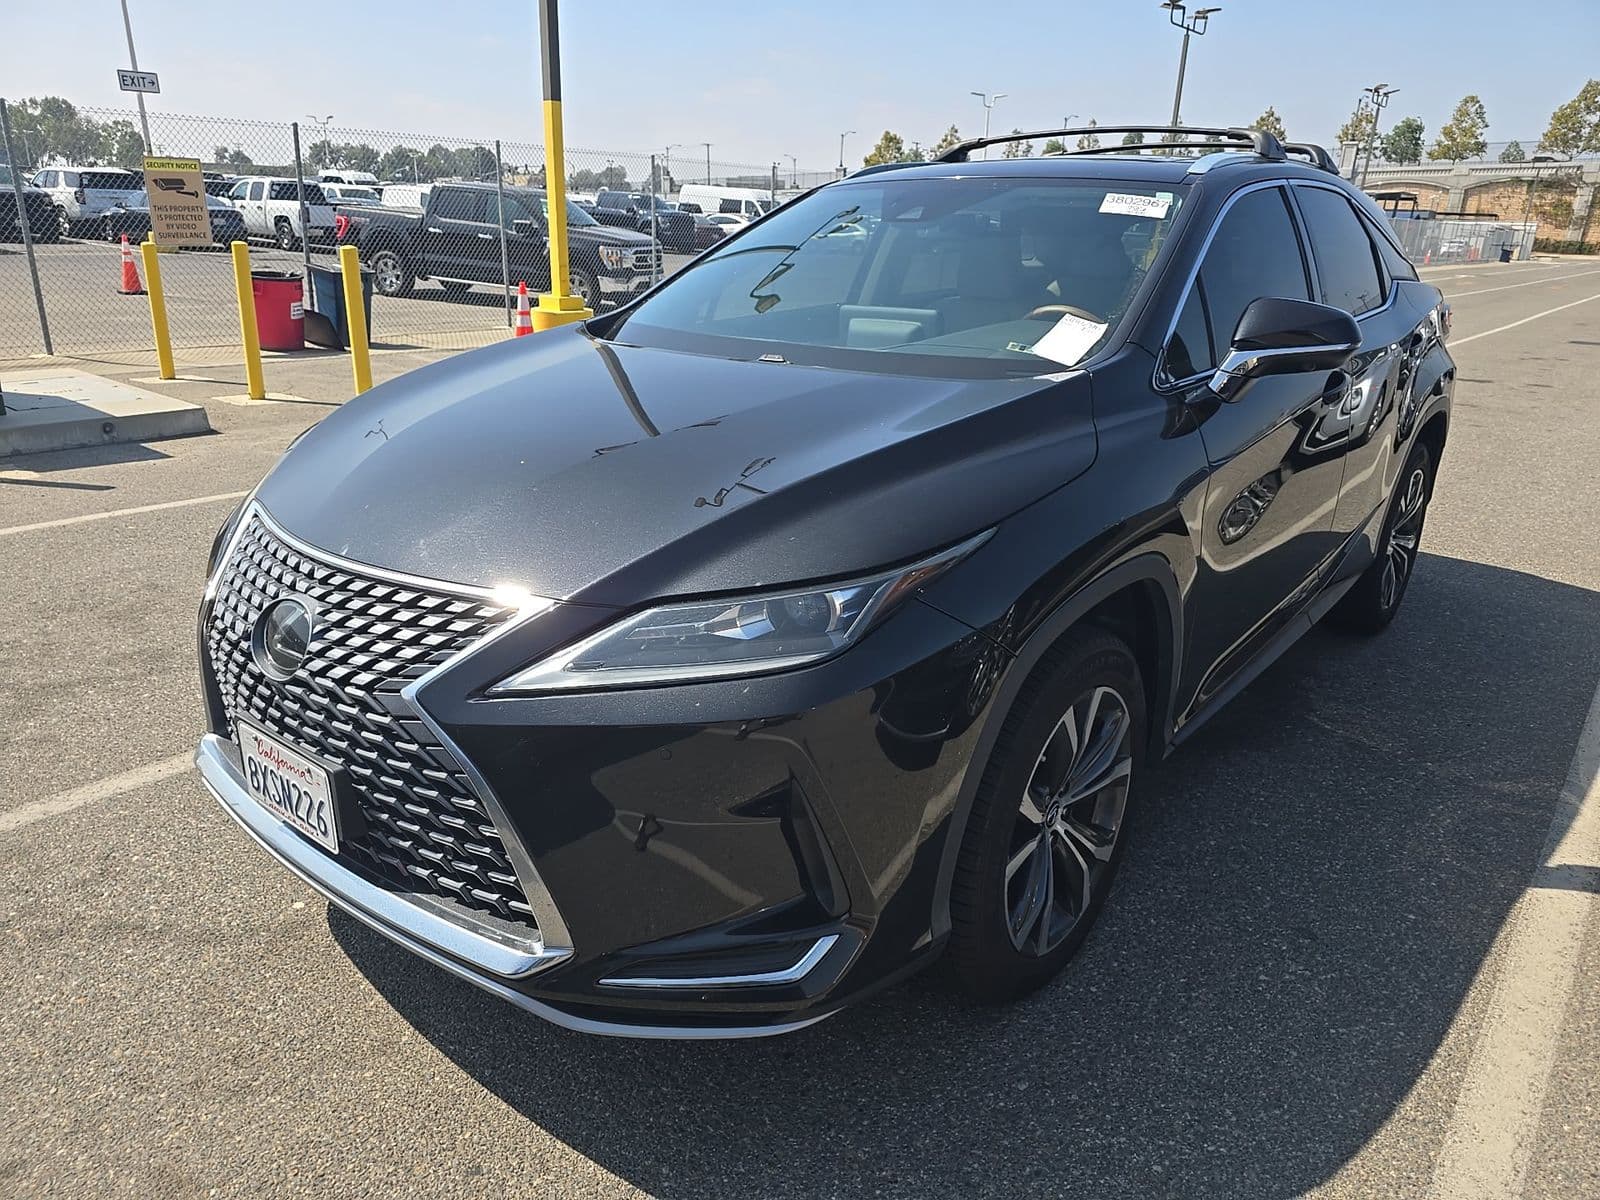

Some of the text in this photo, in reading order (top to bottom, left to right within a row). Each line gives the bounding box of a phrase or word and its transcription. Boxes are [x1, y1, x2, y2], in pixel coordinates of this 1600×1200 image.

[121, 75, 146, 88] EXIT
[146, 161, 175, 169] SECURITY
[1106, 194, 1169, 209] 3802967
[158, 231, 208, 239] SURVEILLANCE
[257, 739, 307, 777] California
[248, 755, 329, 838] 8XSN226
